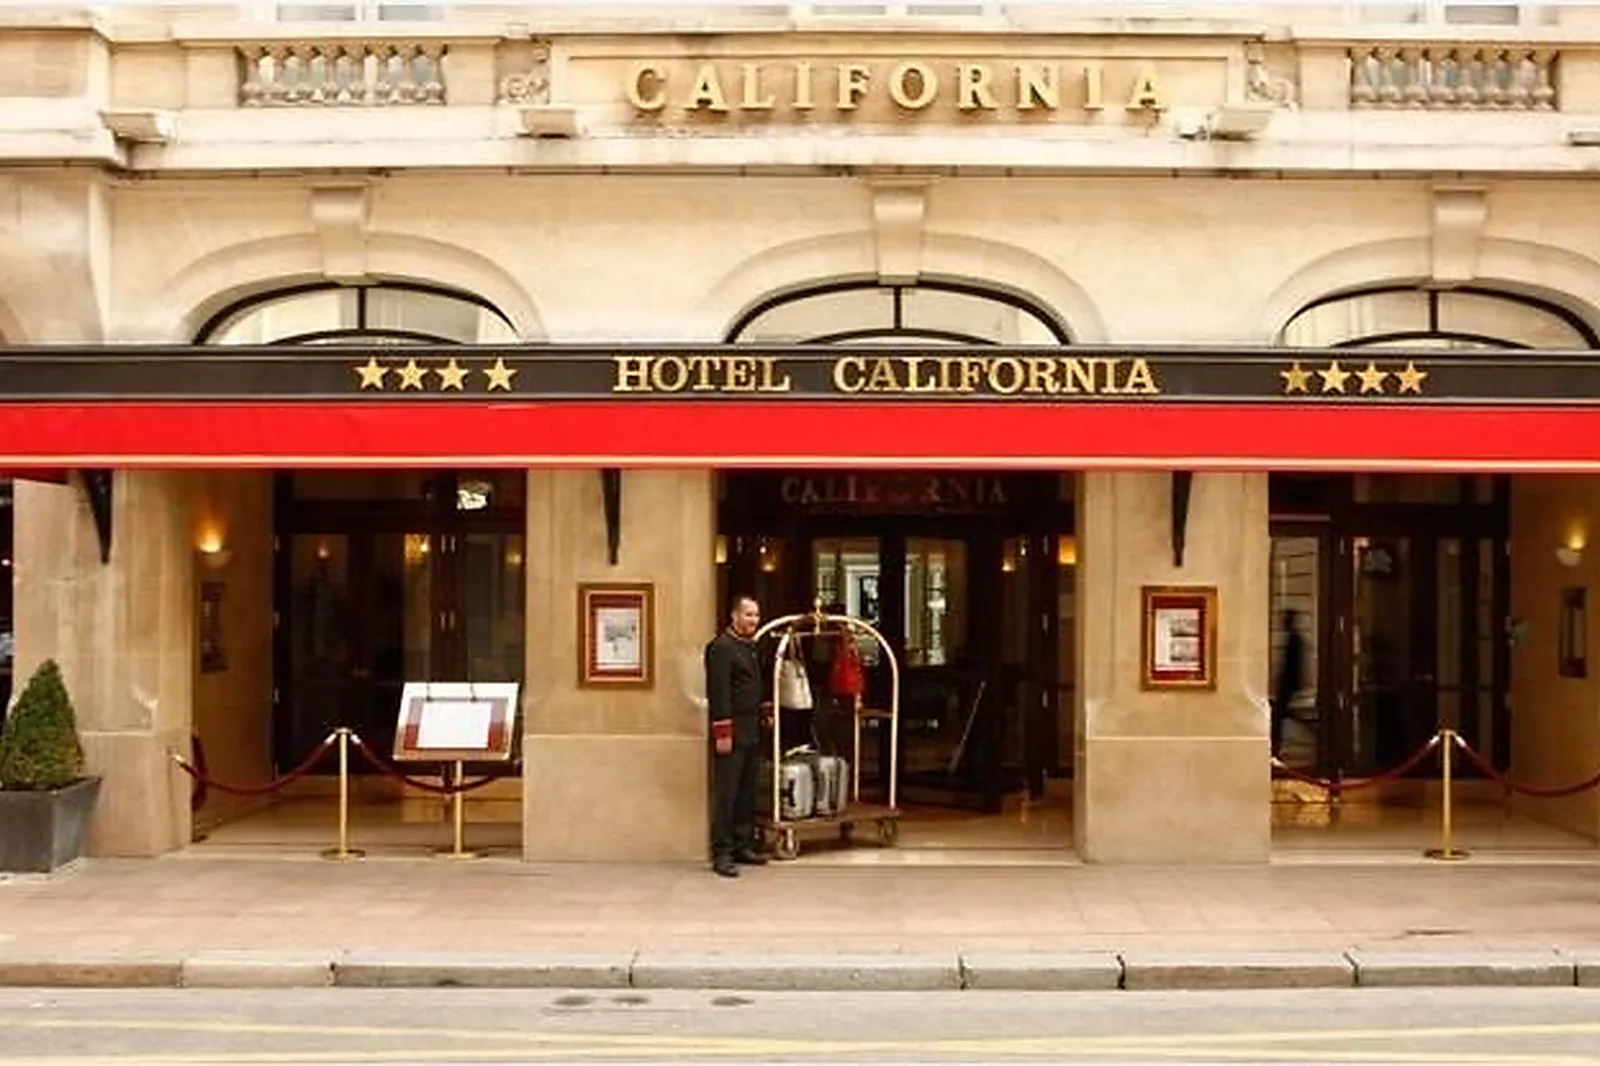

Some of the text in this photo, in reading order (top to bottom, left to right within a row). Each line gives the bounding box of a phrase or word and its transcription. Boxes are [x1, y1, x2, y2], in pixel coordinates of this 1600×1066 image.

[626, 61, 1167, 112] CALIFORNIA
[613, 355, 1160, 395] HOTEL CALIFORNIA
